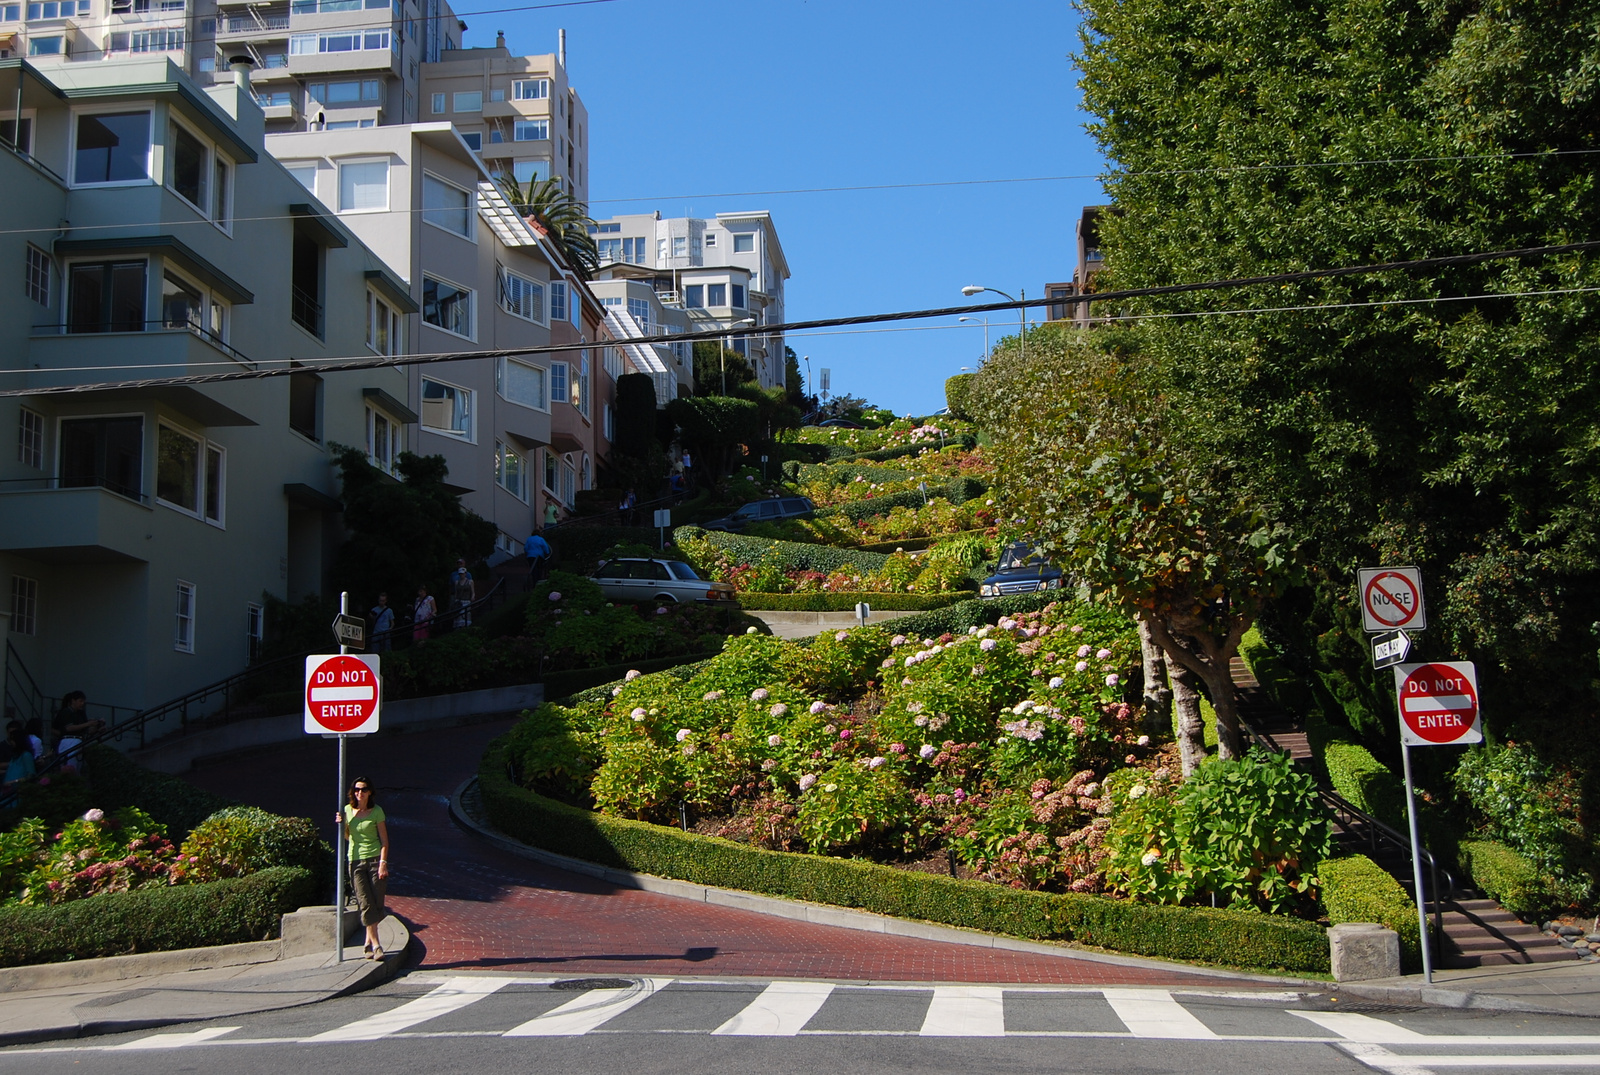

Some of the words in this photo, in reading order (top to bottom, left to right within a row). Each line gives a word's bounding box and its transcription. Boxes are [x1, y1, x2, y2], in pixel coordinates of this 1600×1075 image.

[341, 624, 351, 636] ONE
[352, 626, 362, 640] WAY
[1377, 644, 1387, 658] ONE
[317, 671, 335, 684] DO
[341, 670, 368, 683] NOT
[1408, 680, 1428, 694] DO
[1435, 678, 1463, 691] NOT
[321, 704, 362, 717] ENTER
[1418, 714, 1462, 728] ENTER
